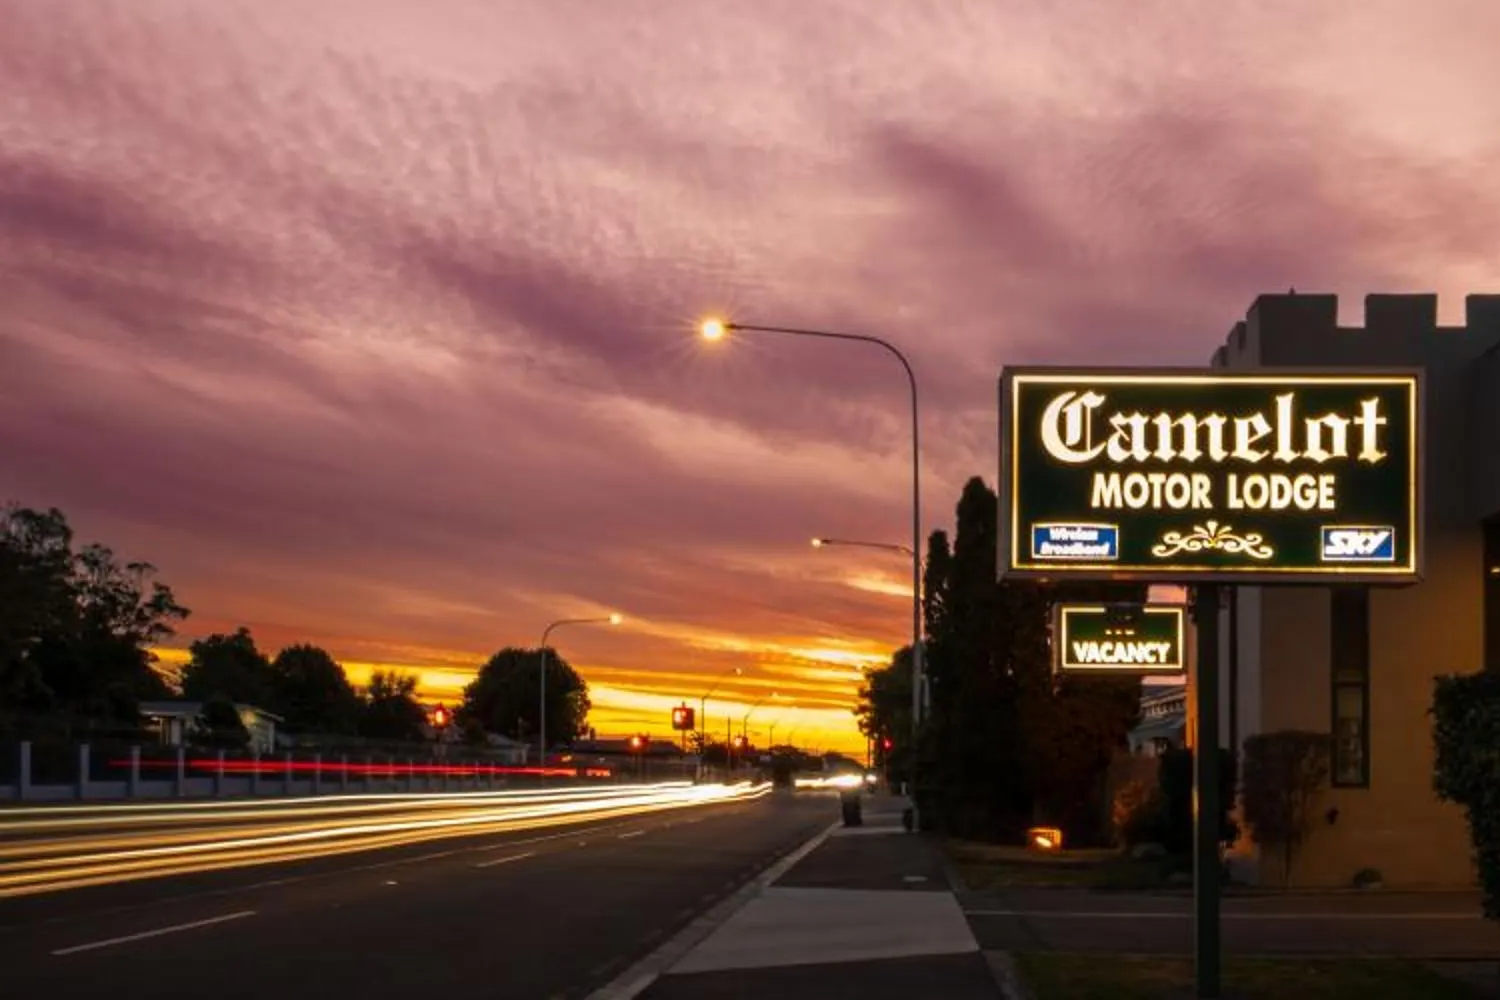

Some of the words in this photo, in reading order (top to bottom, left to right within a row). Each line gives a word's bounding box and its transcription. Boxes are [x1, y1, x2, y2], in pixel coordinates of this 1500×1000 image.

[1041, 391, 1387, 463] Camelot
[1091, 473, 1213, 509] MOTOR
[1227, 473, 1336, 510] LODGE
[1325, 531, 1390, 554] SKY
[1072, 641, 1171, 663] VACANCY
